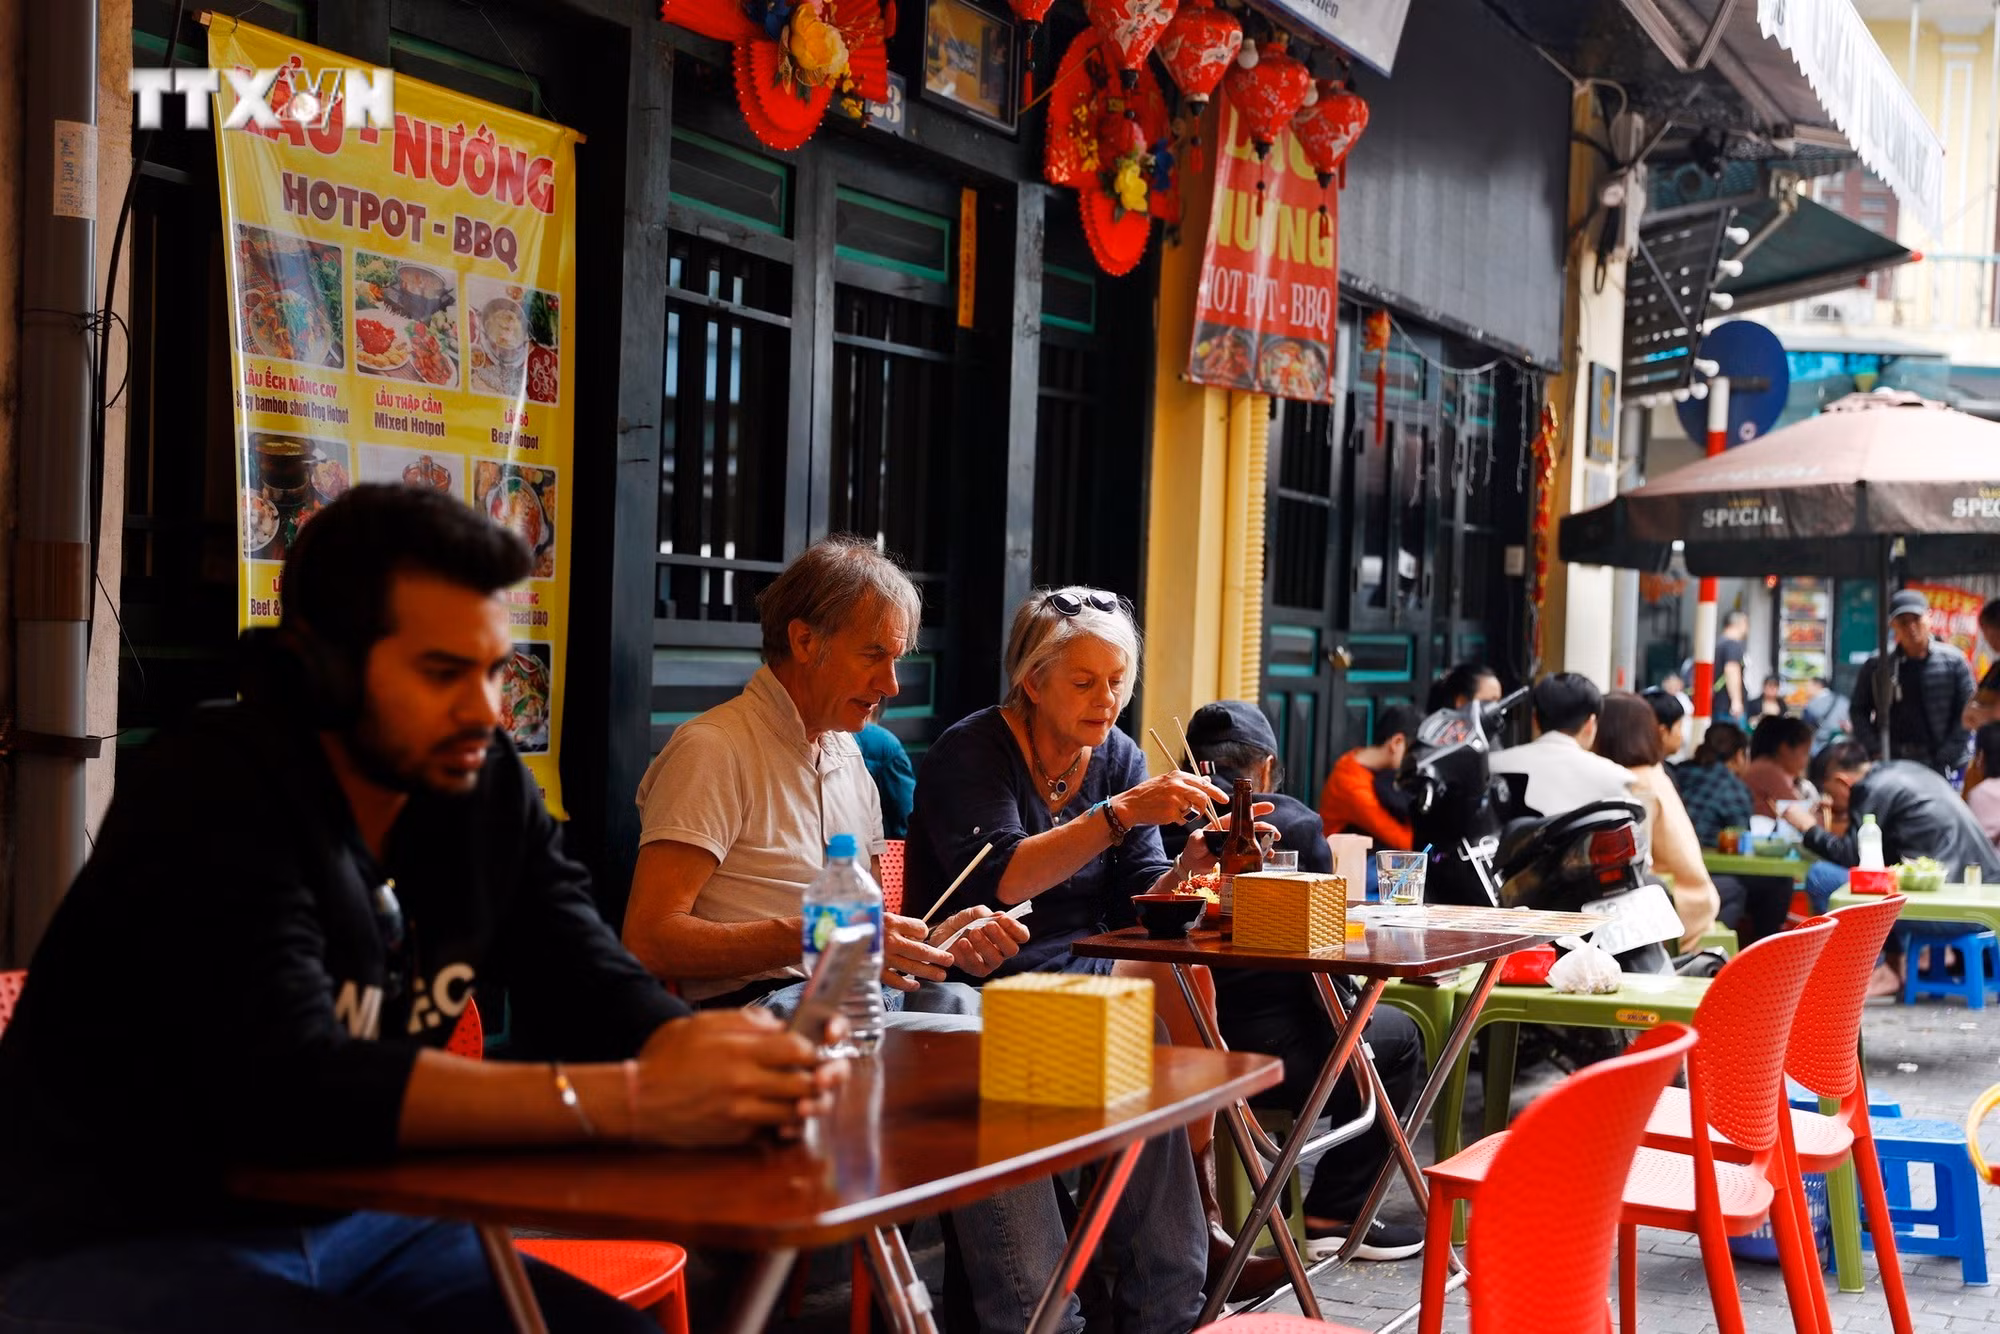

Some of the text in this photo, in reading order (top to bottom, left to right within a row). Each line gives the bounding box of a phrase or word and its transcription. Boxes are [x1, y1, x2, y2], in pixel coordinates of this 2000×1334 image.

[393, 115, 555, 214] NƯỚNG
[282, 172, 426, 243] HOTPOT
[454, 216, 518, 273] BBQ
[1201, 264, 1242, 315] HOT
[1290, 282, 1331, 341] BBQ
[265, 366, 287, 390] ẾCH
[288, 375, 319, 396] MĂNG
[320, 382, 338, 399] CAY
[255, 394, 288, 415] bamboo
[374, 411, 445, 438] Mixed Hotpot
[514, 431, 539, 450] Hotpot
[1702, 505, 1784, 528] SPECIAL
[250, 597, 281, 617] Beef &
[532, 609, 549, 627] BBQ
